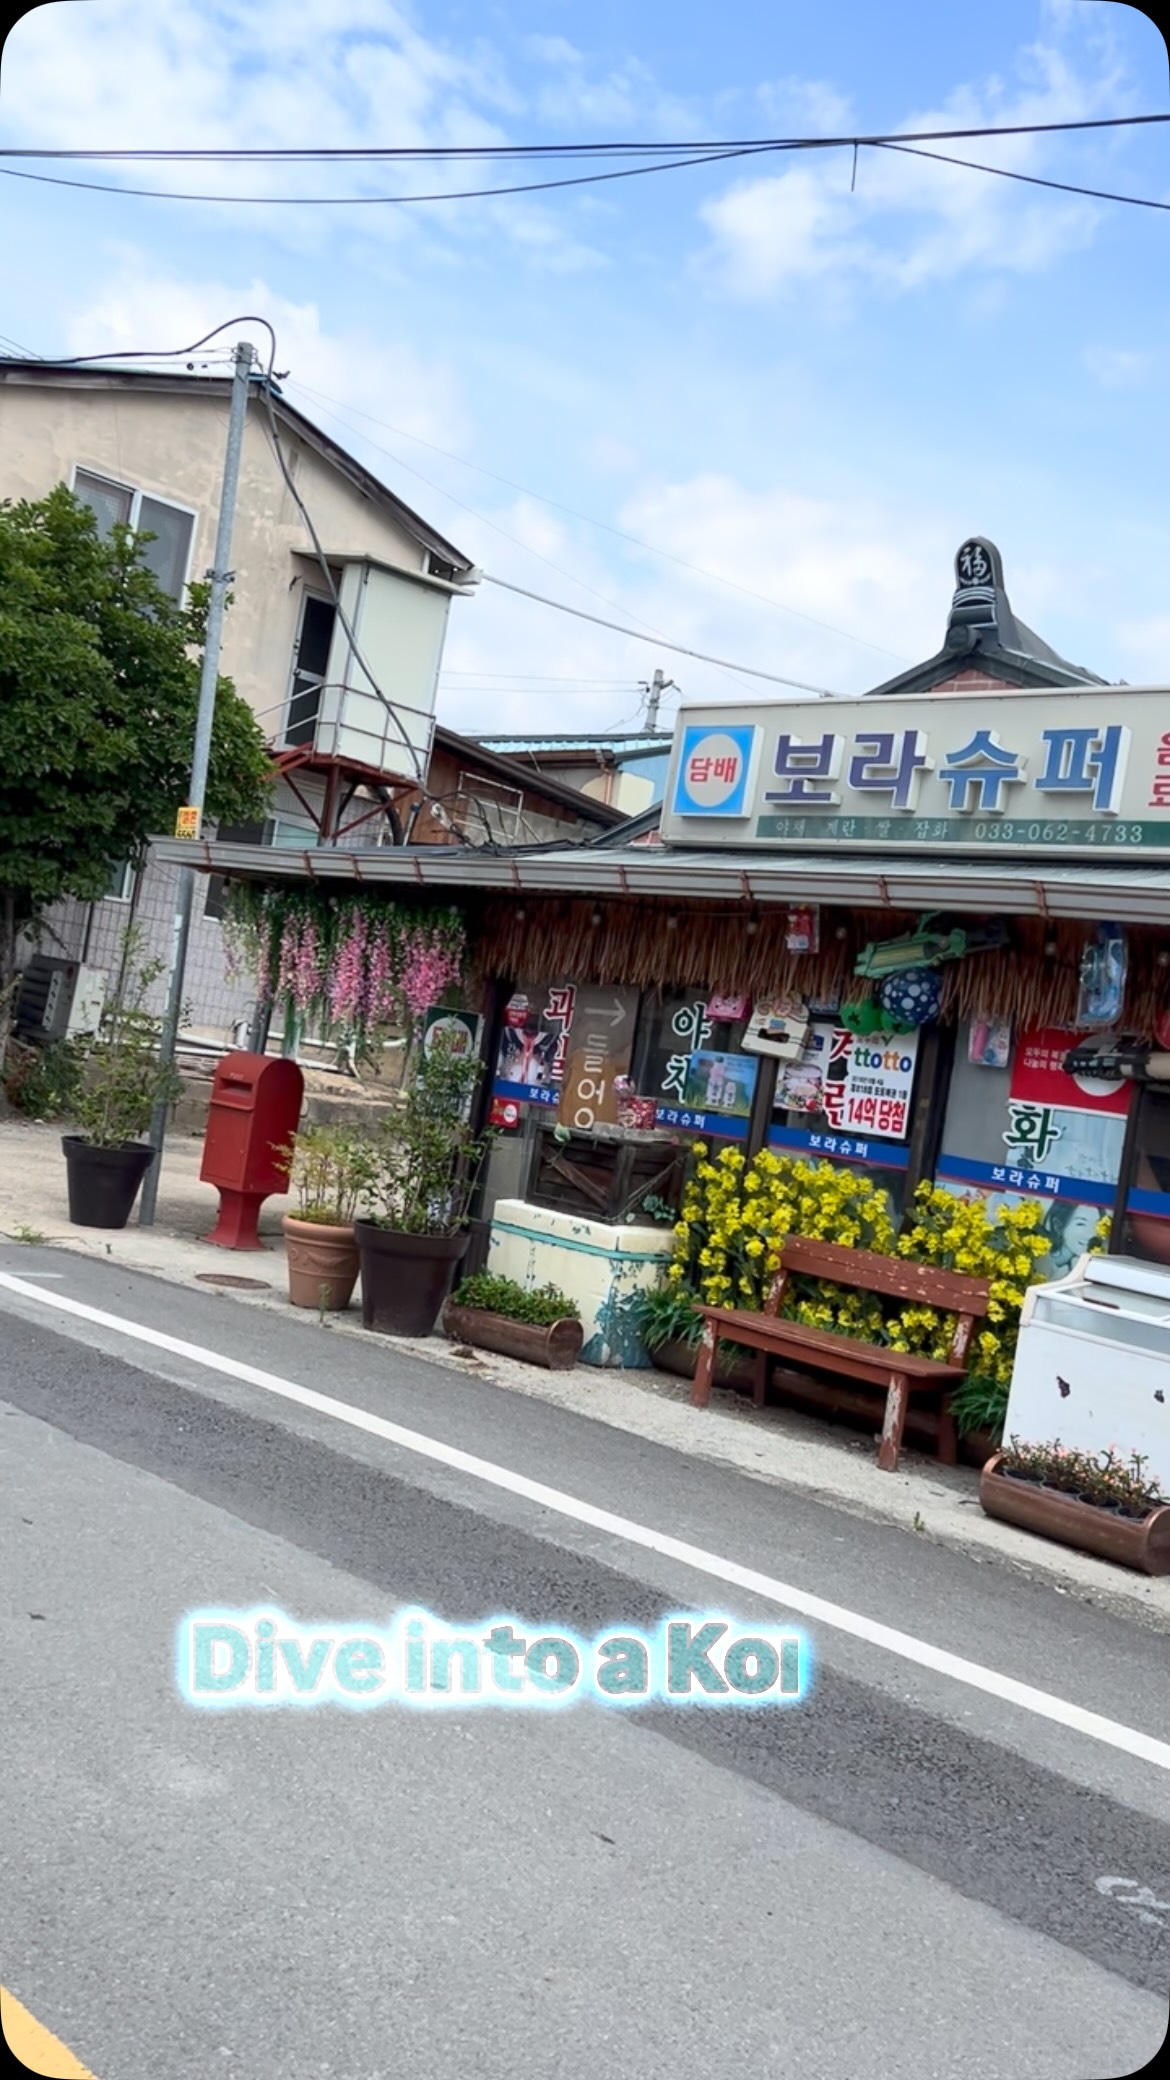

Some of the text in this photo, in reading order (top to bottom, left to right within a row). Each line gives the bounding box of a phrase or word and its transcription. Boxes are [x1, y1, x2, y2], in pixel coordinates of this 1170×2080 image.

[690, 757, 738, 784] 담배
[764, 725, 1124, 812] 보라슈퍼
[775, 819, 806, 838] 야채
[826, 819, 857, 838] 계란
[914, 820, 949, 841] 잡화
[975, 822, 1143, 844] 033-062-4733
[854, 1047, 913, 1073] ttotto
[655, 1108, 706, 1129] 보라슈퍼
[848, 1097, 907, 1133] 14억 당첨
[808, 1134, 869, 1158] 보라슈퍼
[991, 1167, 1061, 1194] 보라슈퍼
